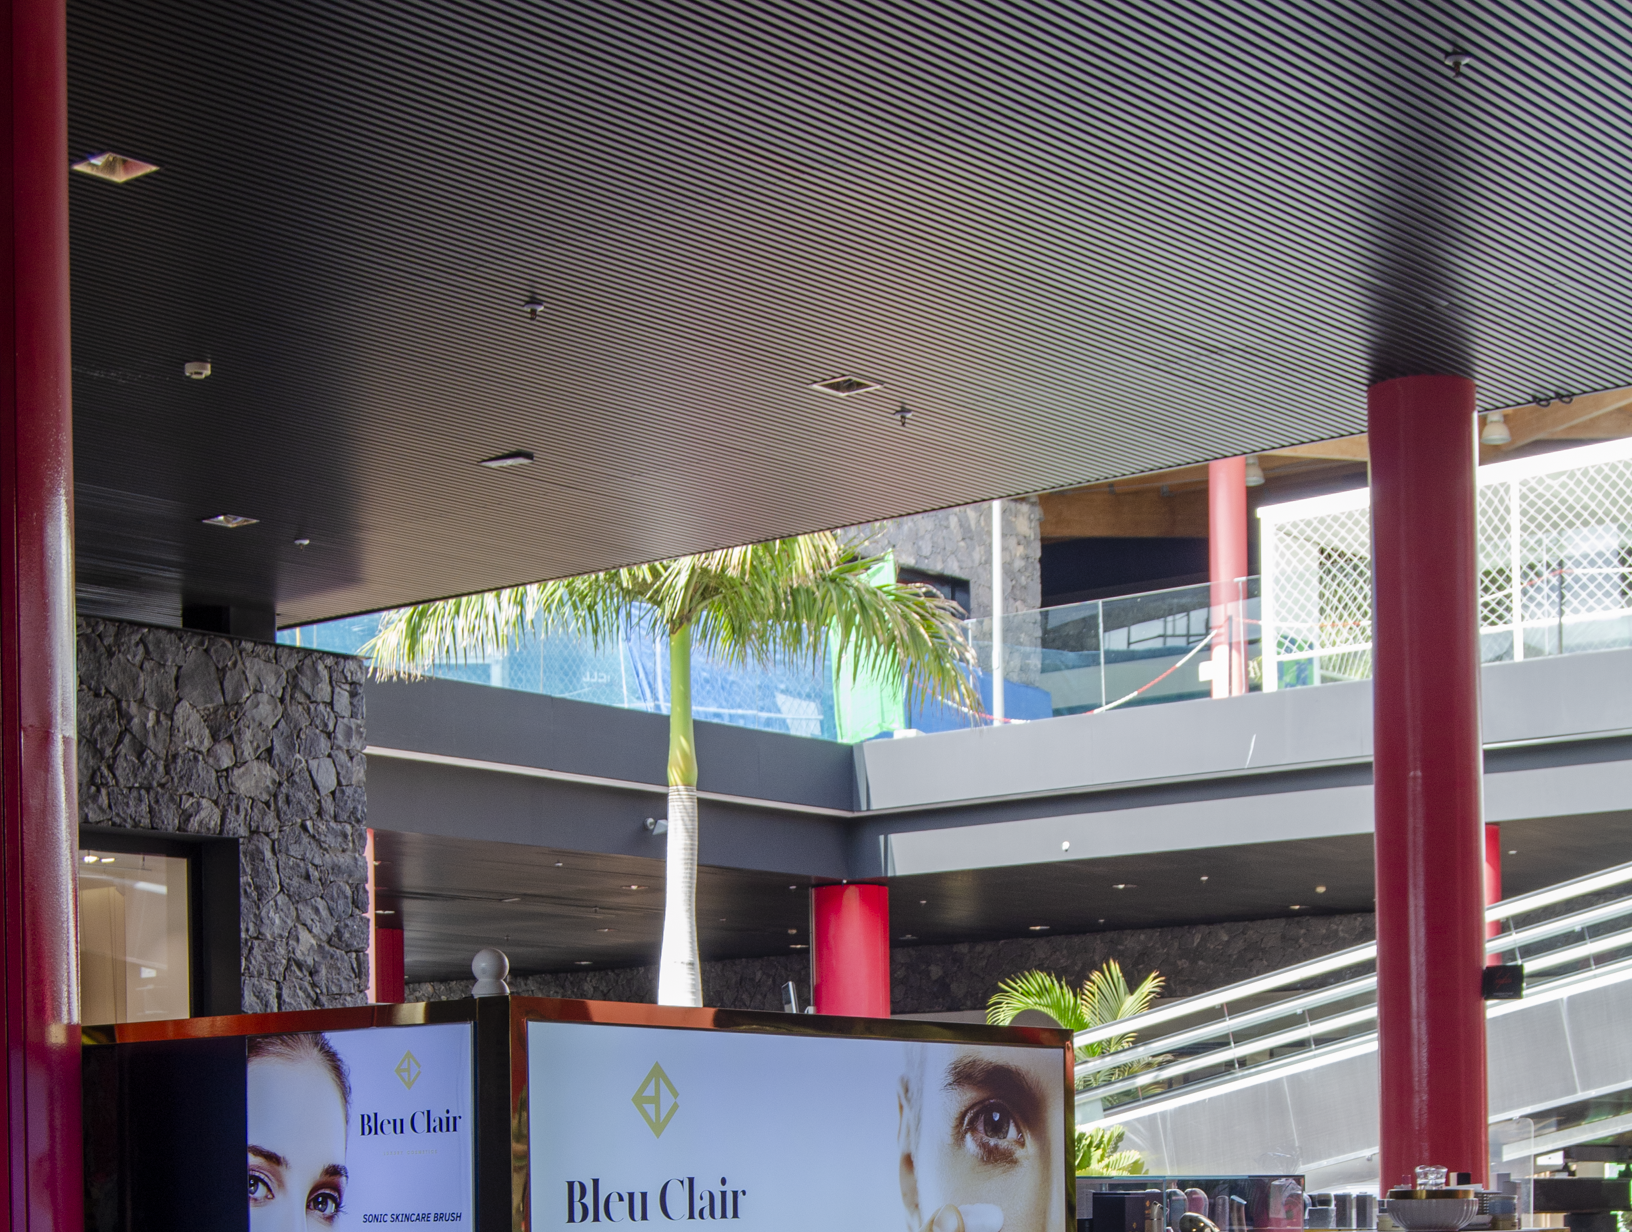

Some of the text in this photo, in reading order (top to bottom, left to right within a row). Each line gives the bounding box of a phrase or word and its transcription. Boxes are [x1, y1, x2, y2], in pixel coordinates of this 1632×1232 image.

[360, 1108, 462, 1136] Bleu Clair
[565, 1176, 747, 1224] Bleu Clair
[362, 1212, 462, 1223] SONIC SKINCARE BRUSH
